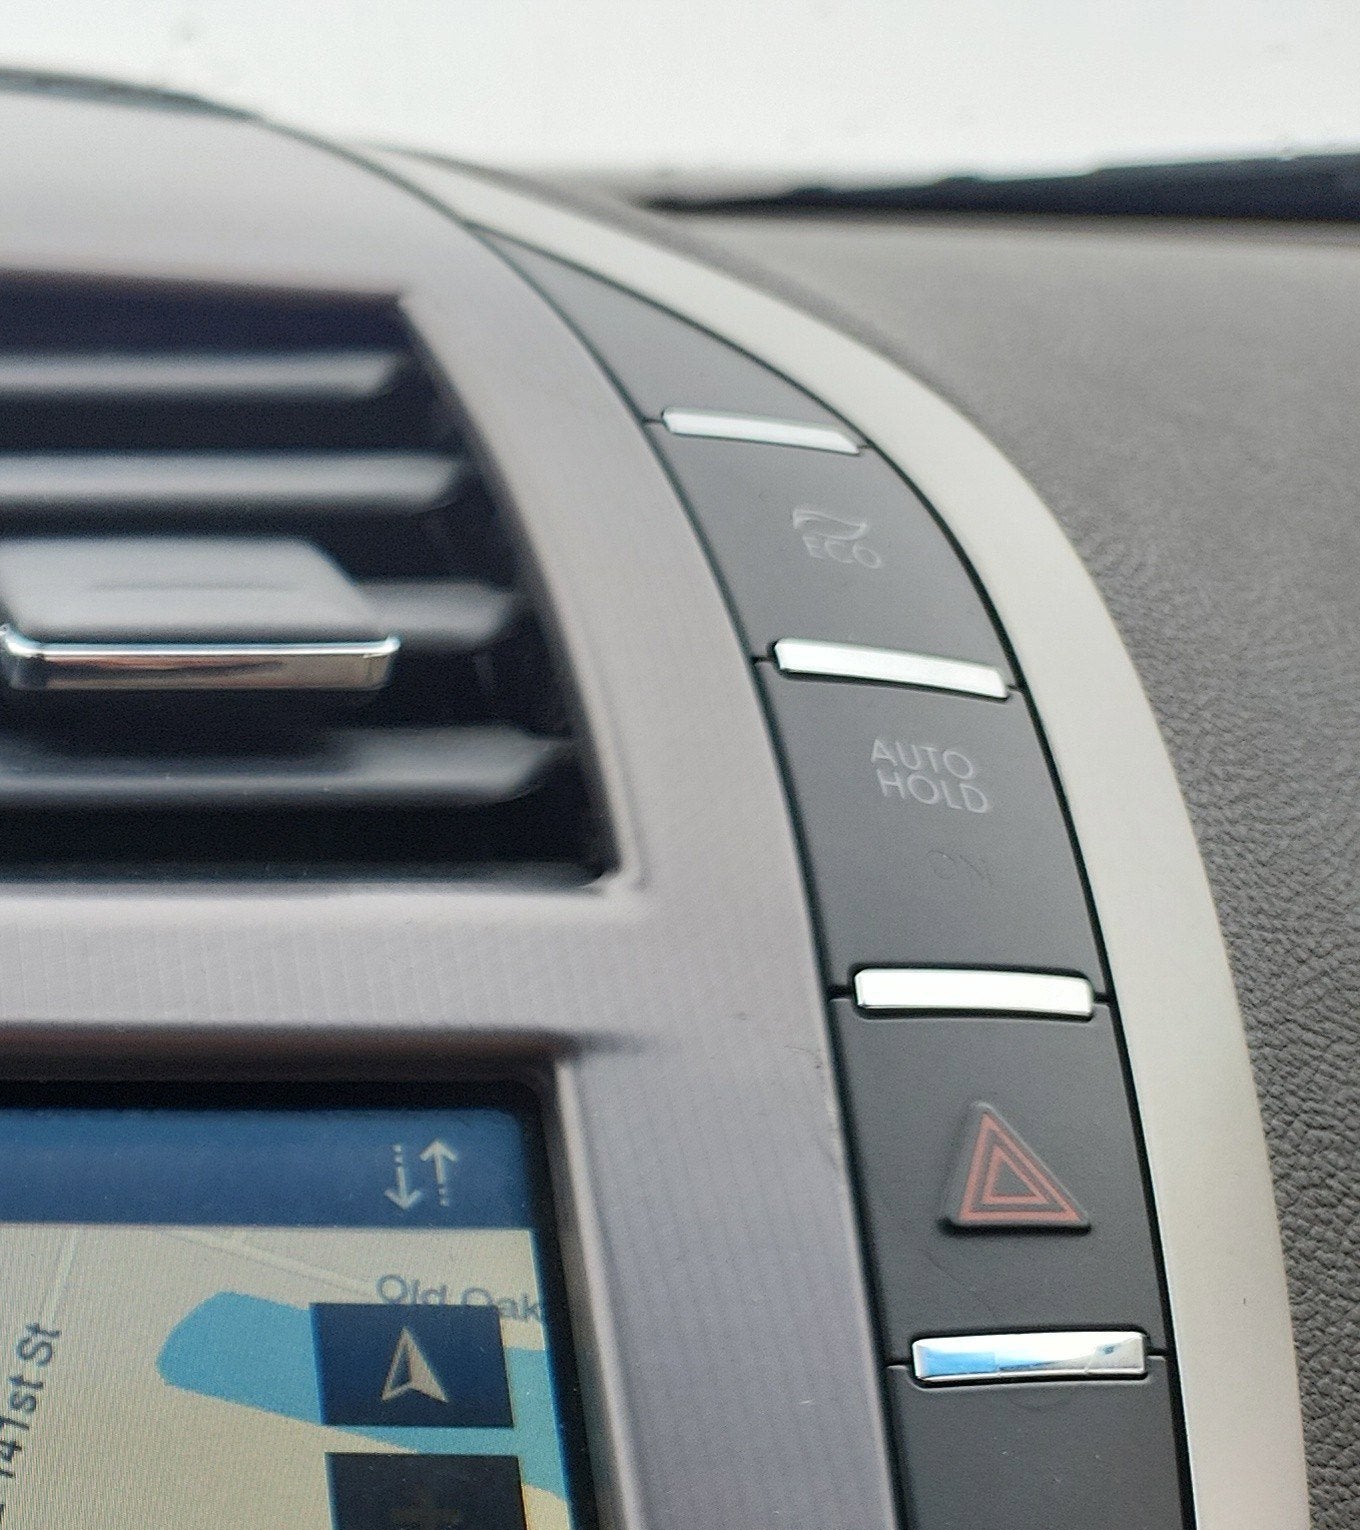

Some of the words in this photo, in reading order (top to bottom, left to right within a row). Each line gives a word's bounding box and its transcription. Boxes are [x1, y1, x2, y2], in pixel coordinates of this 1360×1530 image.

[802, 533, 886, 571] ECO
[870, 735, 979, 781] AUTO
[875, 767, 993, 814] HOLD
[15, 1322, 63, 1368] St
